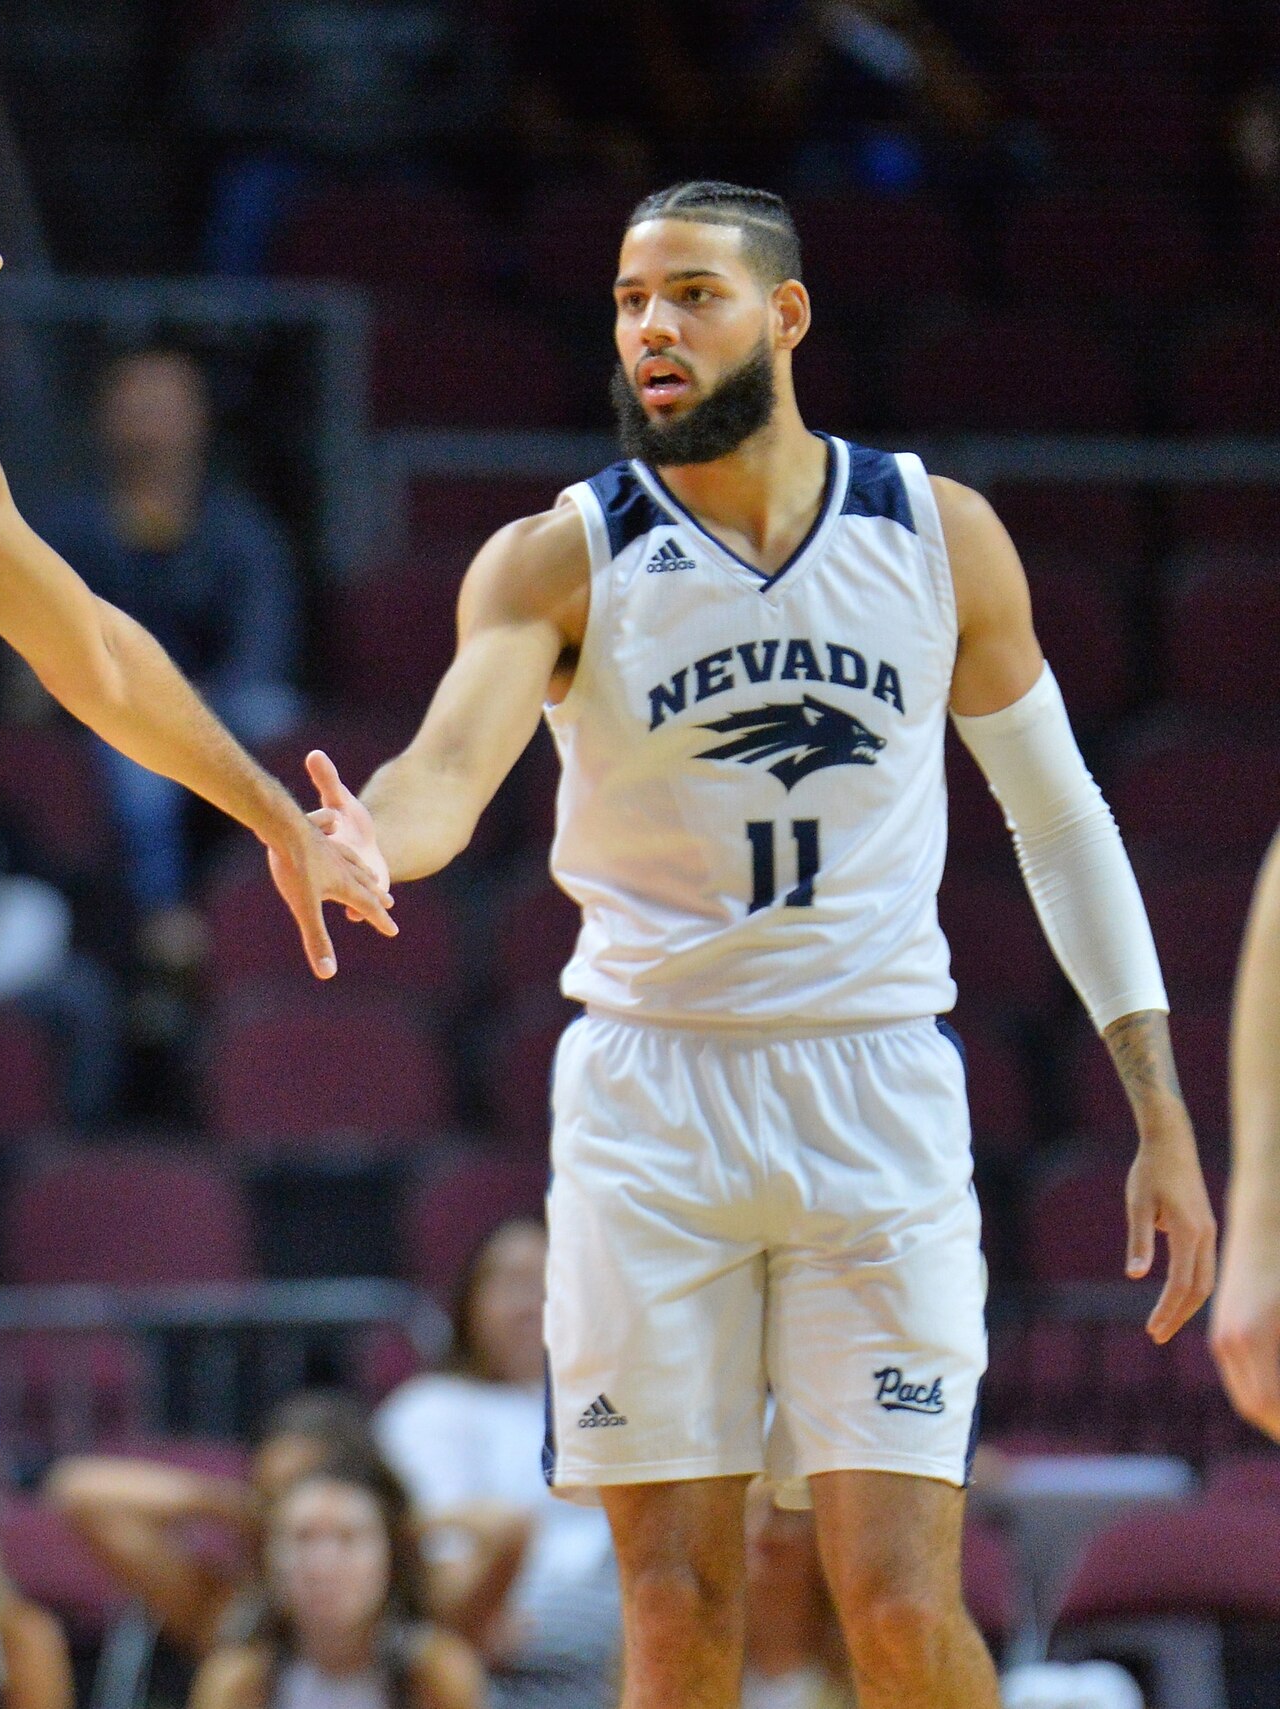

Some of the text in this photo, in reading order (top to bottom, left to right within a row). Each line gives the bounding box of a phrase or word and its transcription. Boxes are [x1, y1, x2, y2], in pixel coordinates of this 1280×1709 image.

[646, 558, 697, 573] adidas
[647, 638, 906, 732] NEVADA
[745, 818, 819, 916] 11
[873, 1366, 945, 1414] Pack
